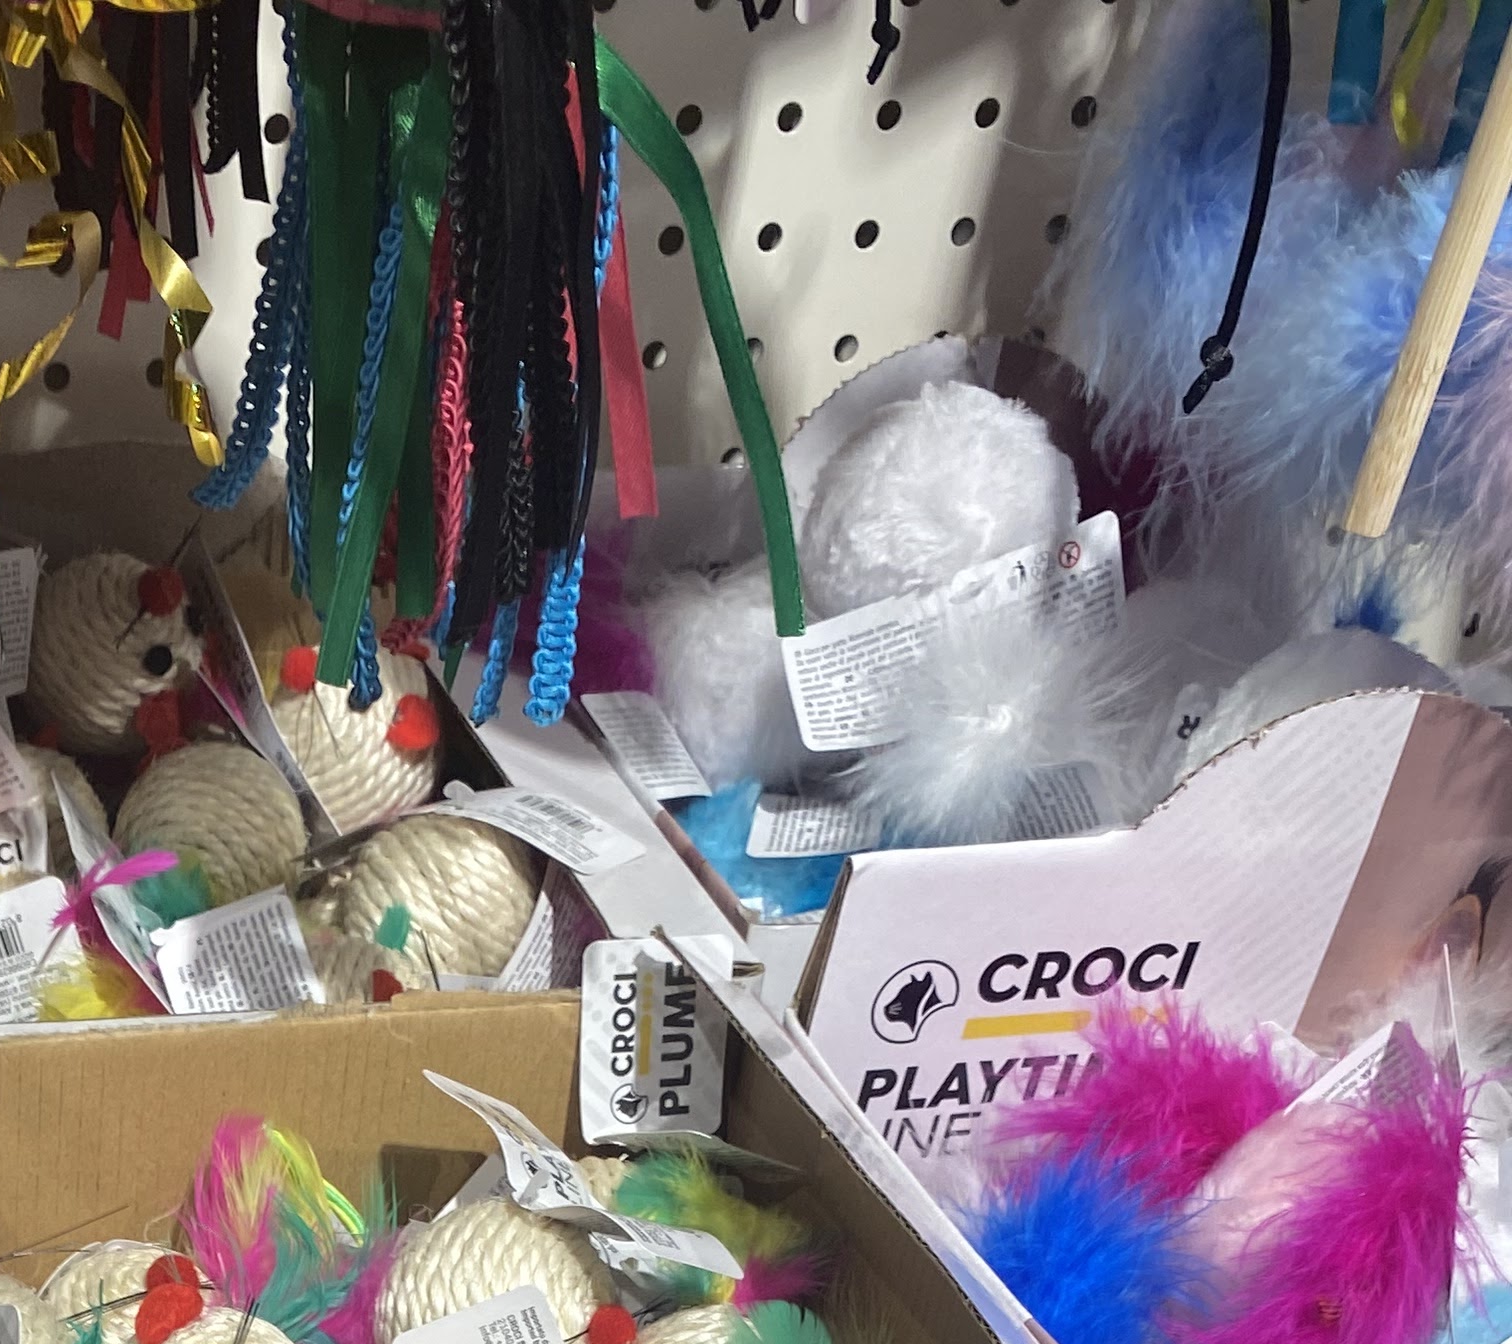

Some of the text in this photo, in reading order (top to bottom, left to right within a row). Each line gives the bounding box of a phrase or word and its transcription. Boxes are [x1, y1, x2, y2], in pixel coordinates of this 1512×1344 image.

[976, 940, 1200, 1001] CROCI
[610, 972, 637, 1077] CROCI
[857, 1053, 1103, 1113] PLAYTI
